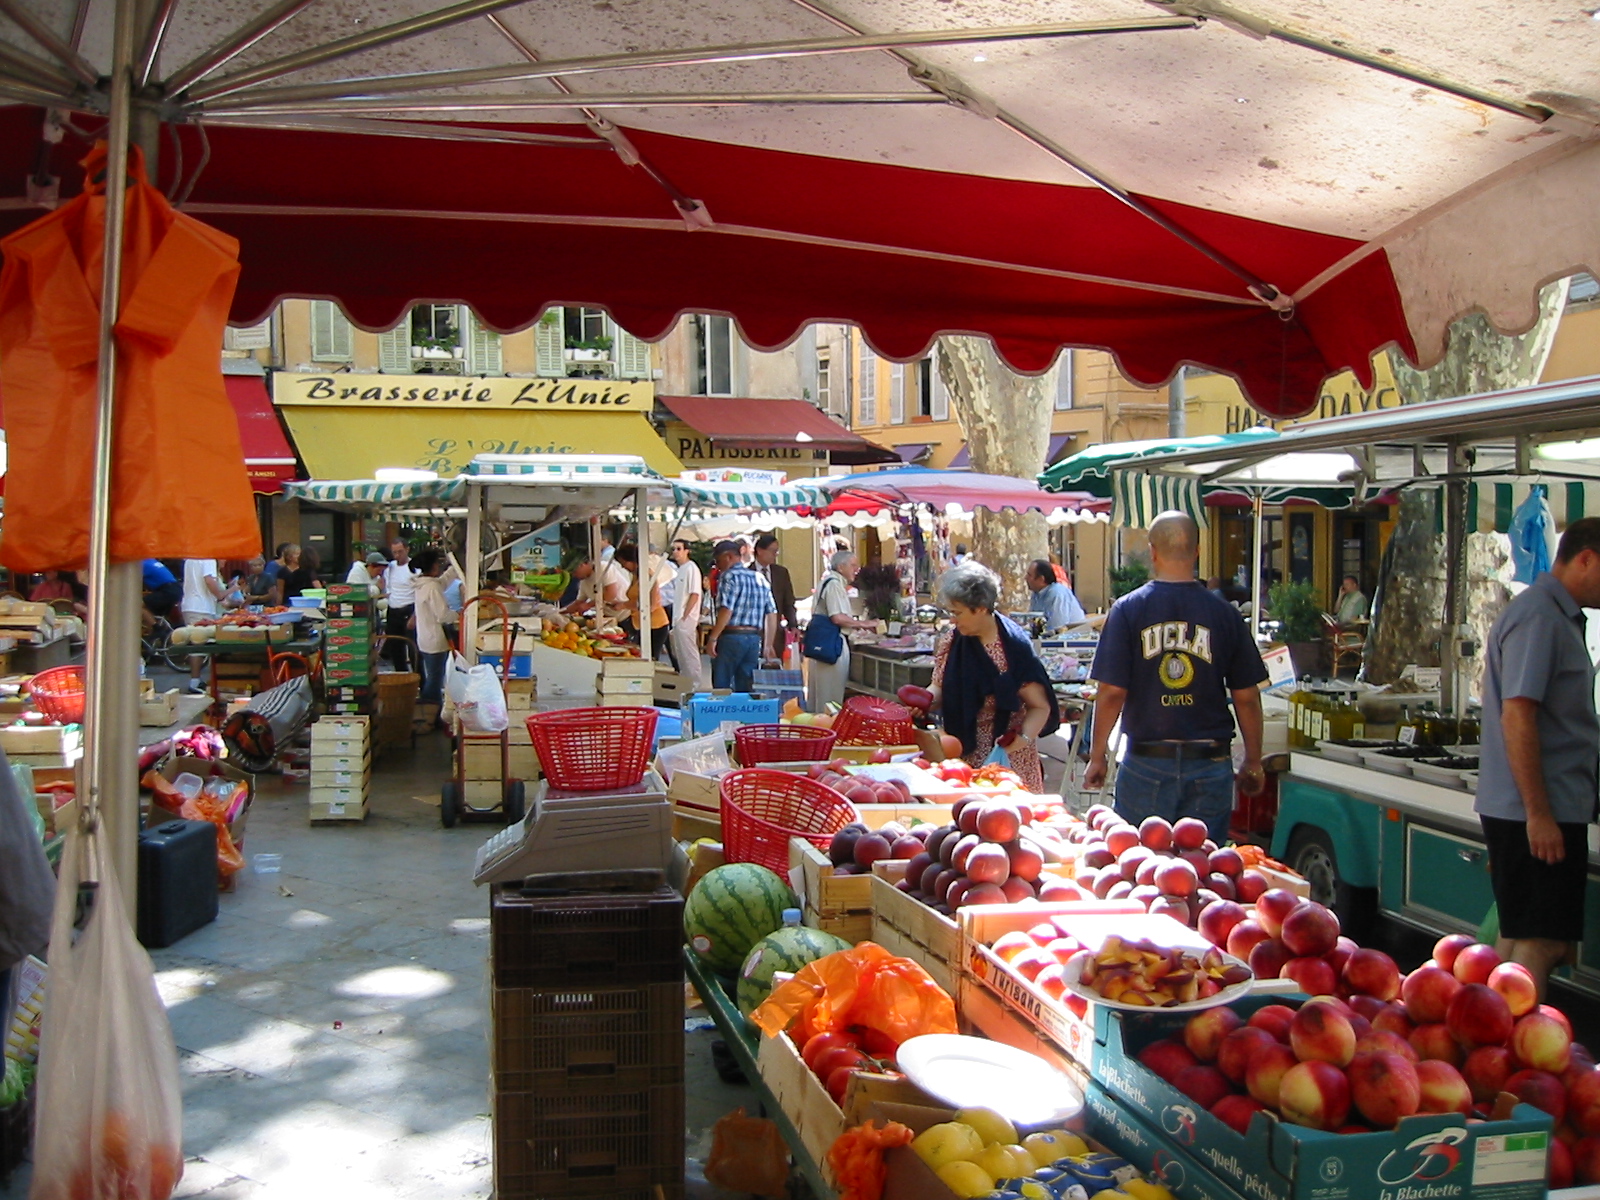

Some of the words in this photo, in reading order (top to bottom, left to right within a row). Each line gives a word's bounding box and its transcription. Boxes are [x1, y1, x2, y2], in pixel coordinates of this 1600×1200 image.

[297, 377, 493, 402] Brasserie
[511, 380, 632, 406] L'Unic
[1140, 620, 1213, 665] UCLA
[1161, 693, 1194, 707] CAMPUS
[700, 704, 770, 714] HAUTES-ALPES
[1396, 1183, 1462, 1200] Blachette
